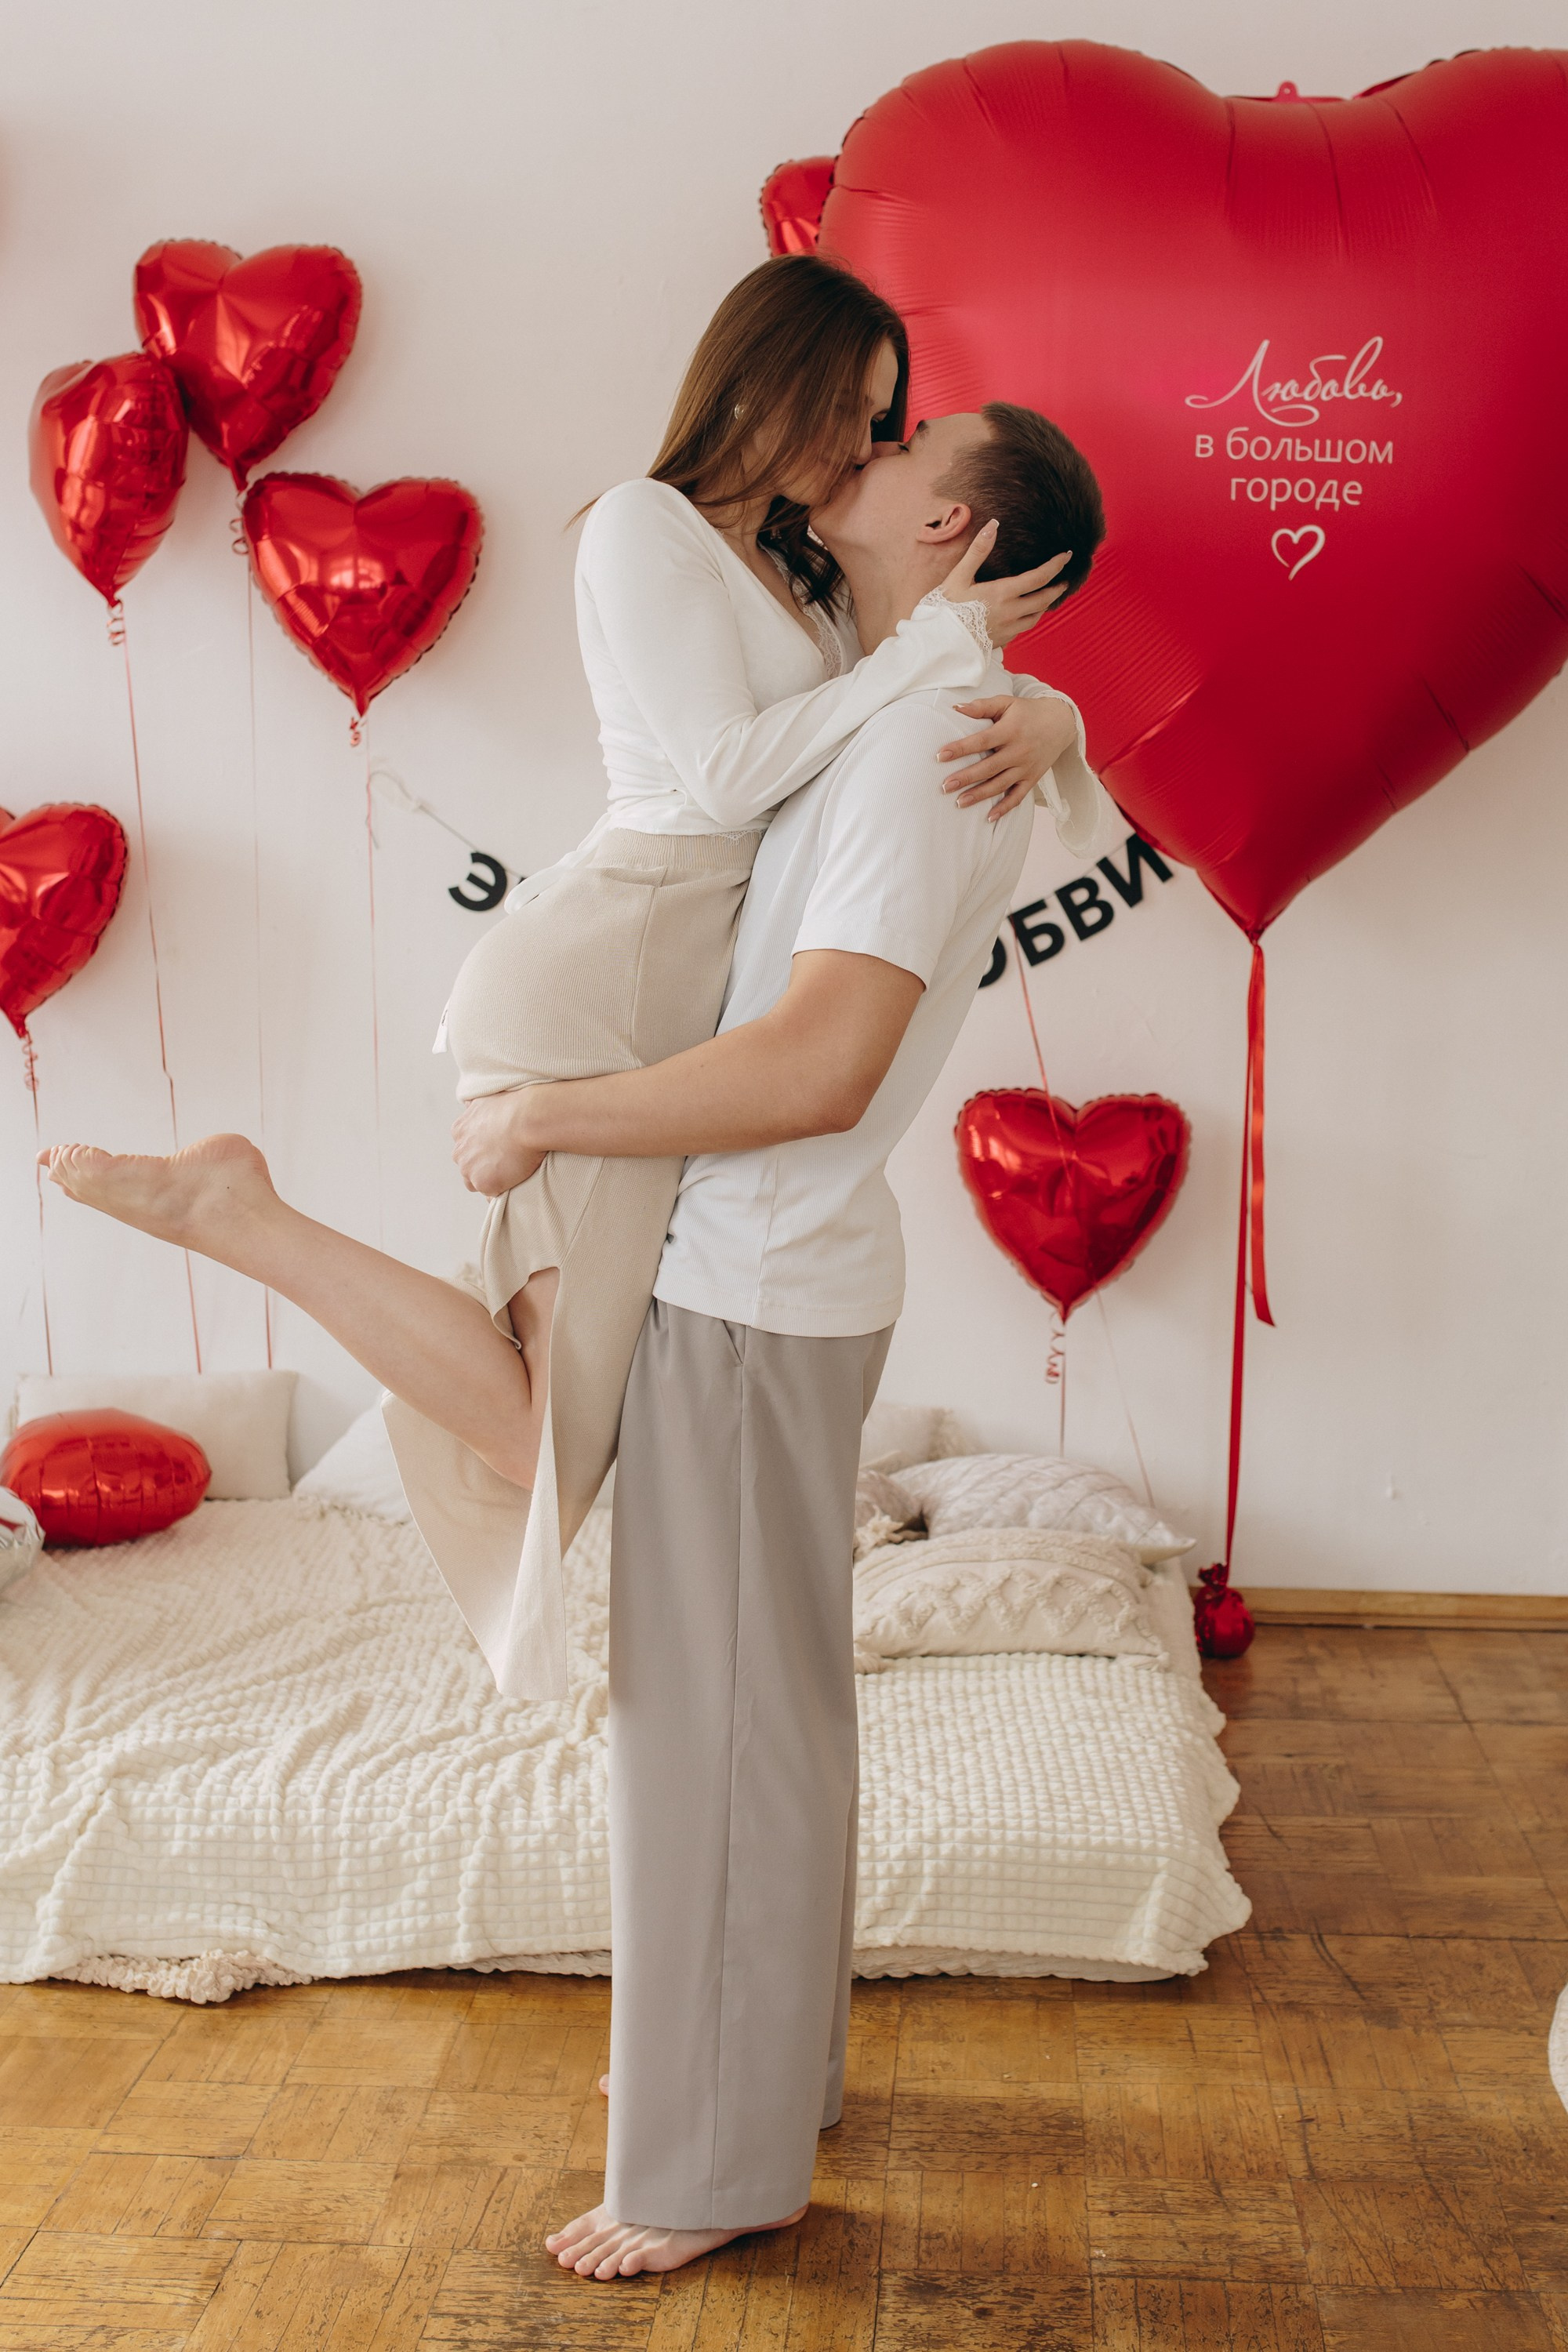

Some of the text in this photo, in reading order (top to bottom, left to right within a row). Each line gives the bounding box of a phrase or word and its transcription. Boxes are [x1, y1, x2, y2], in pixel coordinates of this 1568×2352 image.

[1185, 336, 1403, 427] Любовь,
[1195, 426, 1394, 464] в большом
[1230, 477, 1363, 512] городе
[977, 832, 1174, 989] БВИ
